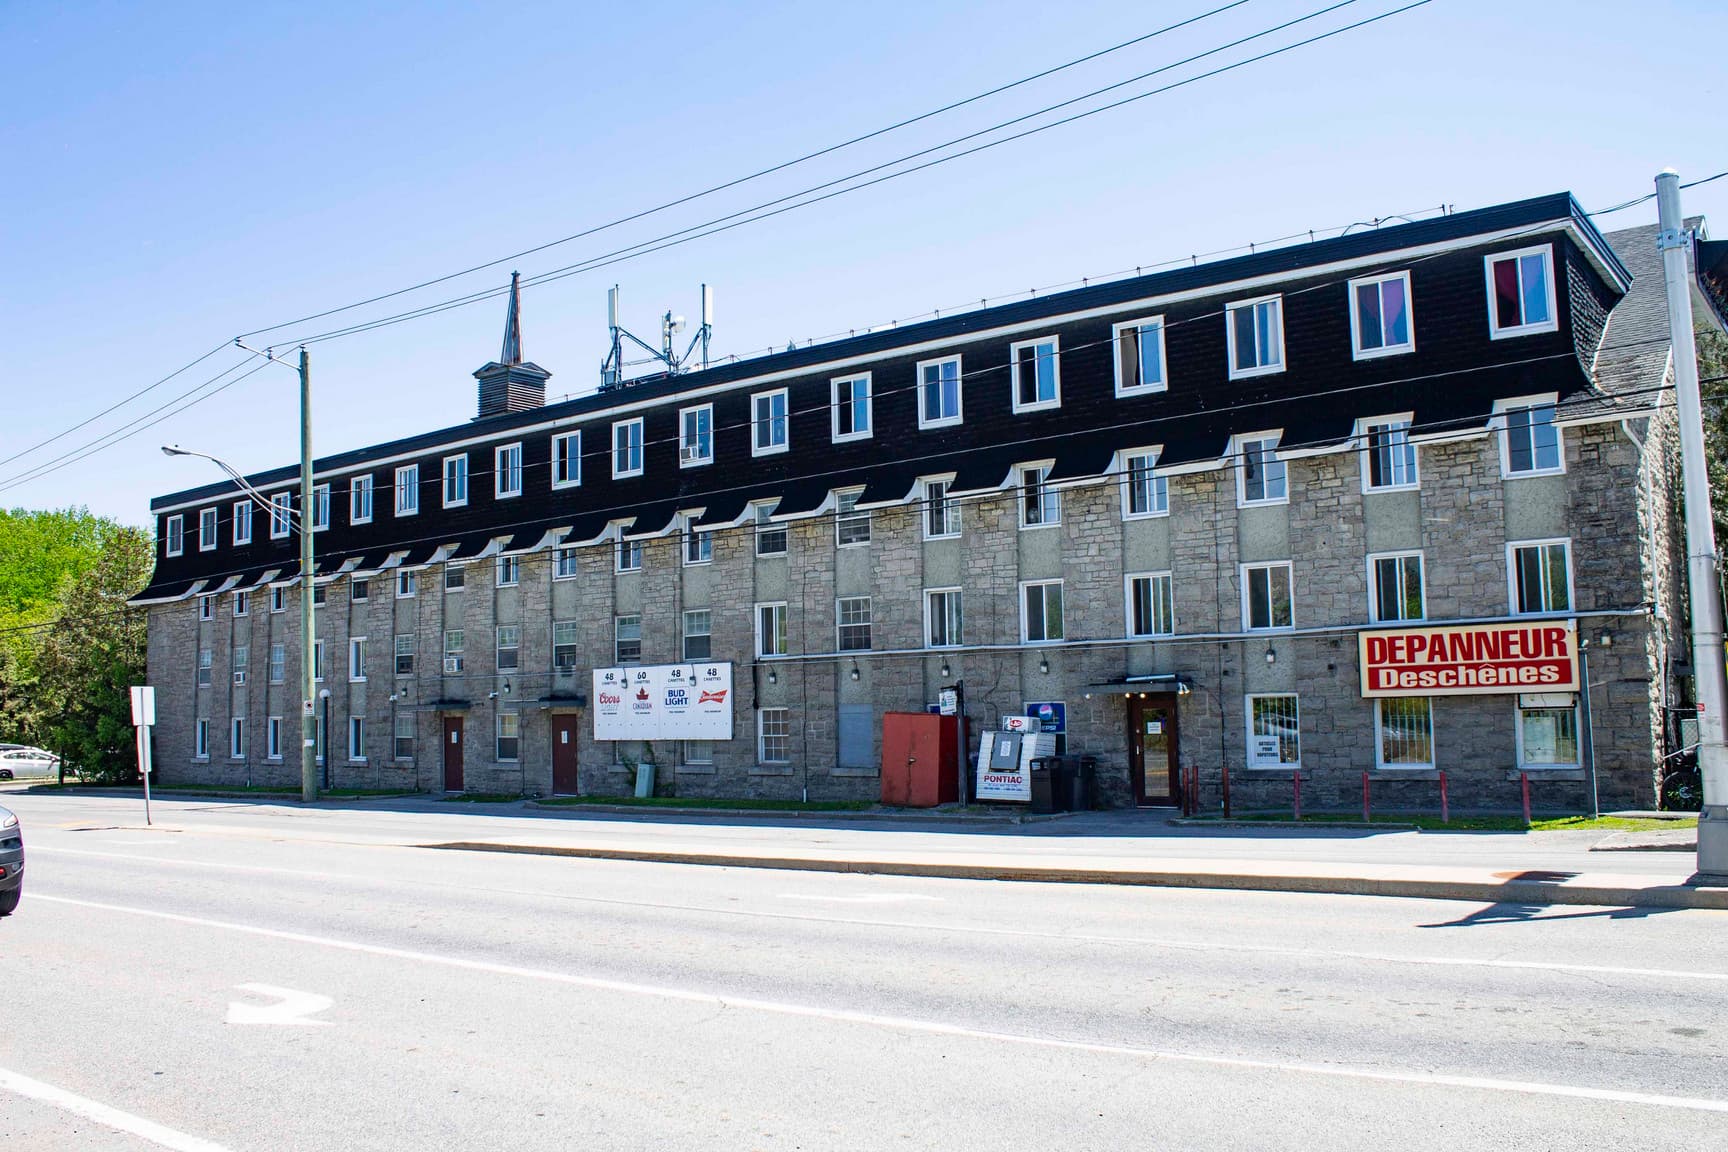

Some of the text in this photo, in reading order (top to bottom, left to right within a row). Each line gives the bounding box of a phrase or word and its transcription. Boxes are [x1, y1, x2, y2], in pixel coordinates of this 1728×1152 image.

[1367, 627, 1568, 665] DEPANNEUR
[637, 671, 647, 680] 60
[671, 669, 681, 678] 48
[706, 667, 718, 676] 48
[1379, 663, 1560, 689] Deschênes
[604, 672, 614, 681] 48
[667, 689, 686, 697] BUD
[599, 692, 621, 704] Coors
[665, 697, 689, 706] LIGHT
[983, 774, 1023, 785] PONTIAC
